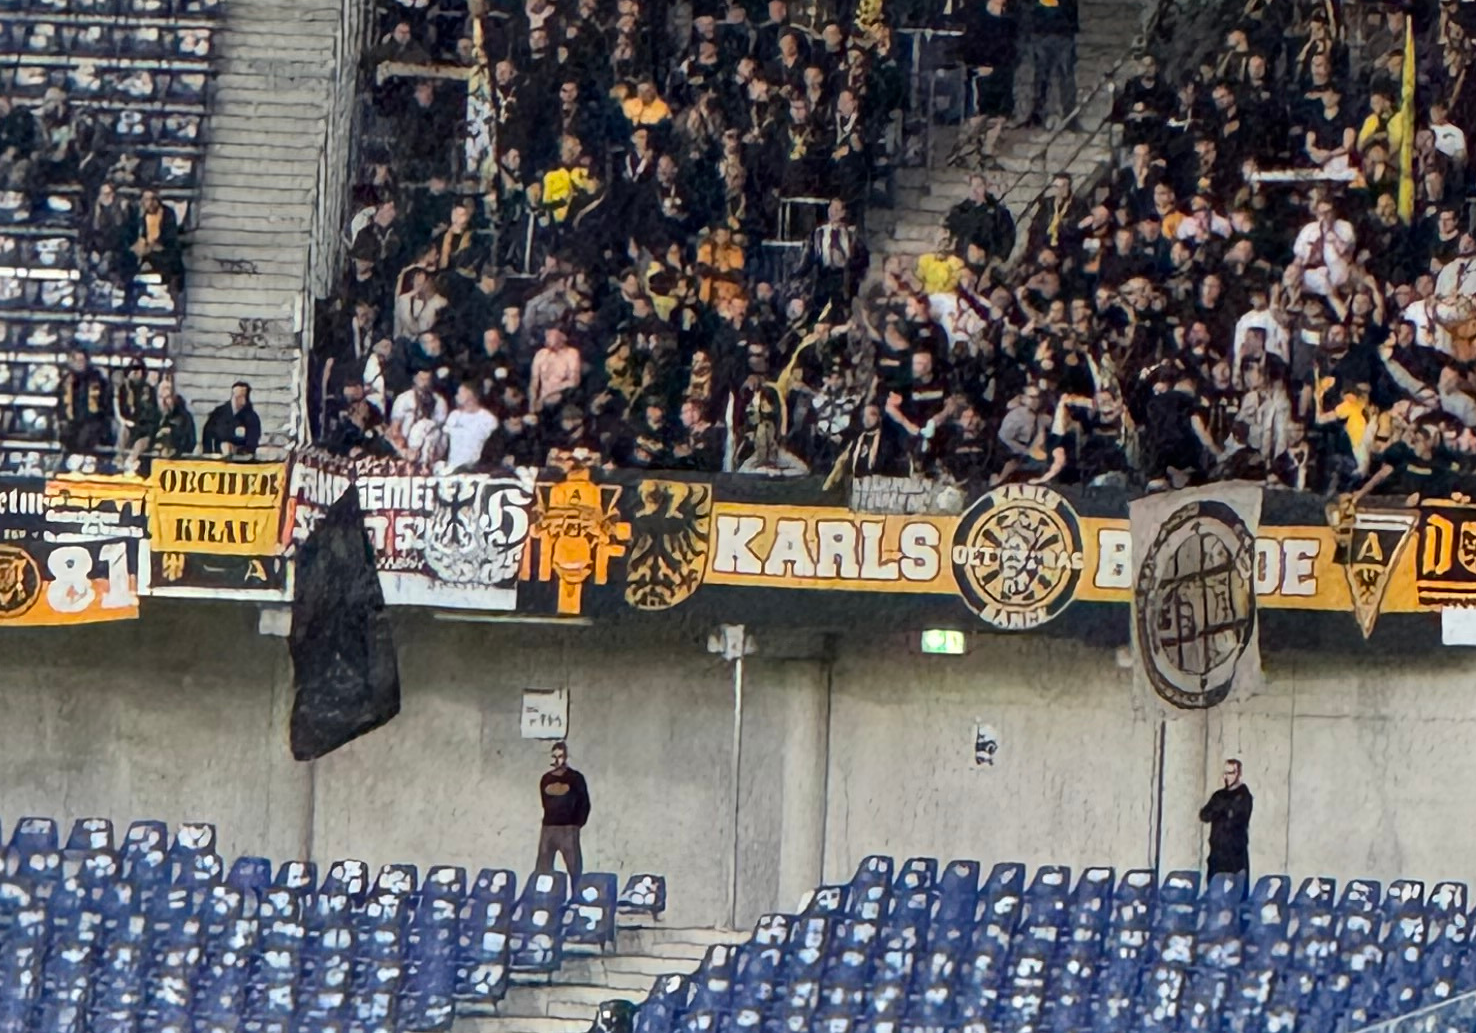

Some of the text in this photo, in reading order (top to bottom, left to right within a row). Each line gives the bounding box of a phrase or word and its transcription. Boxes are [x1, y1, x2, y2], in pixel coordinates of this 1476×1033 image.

[46, 541, 135, 613] 81
[714, 515, 1321, 596] KARLS BDE
[1356, 531, 1384, 561] A
